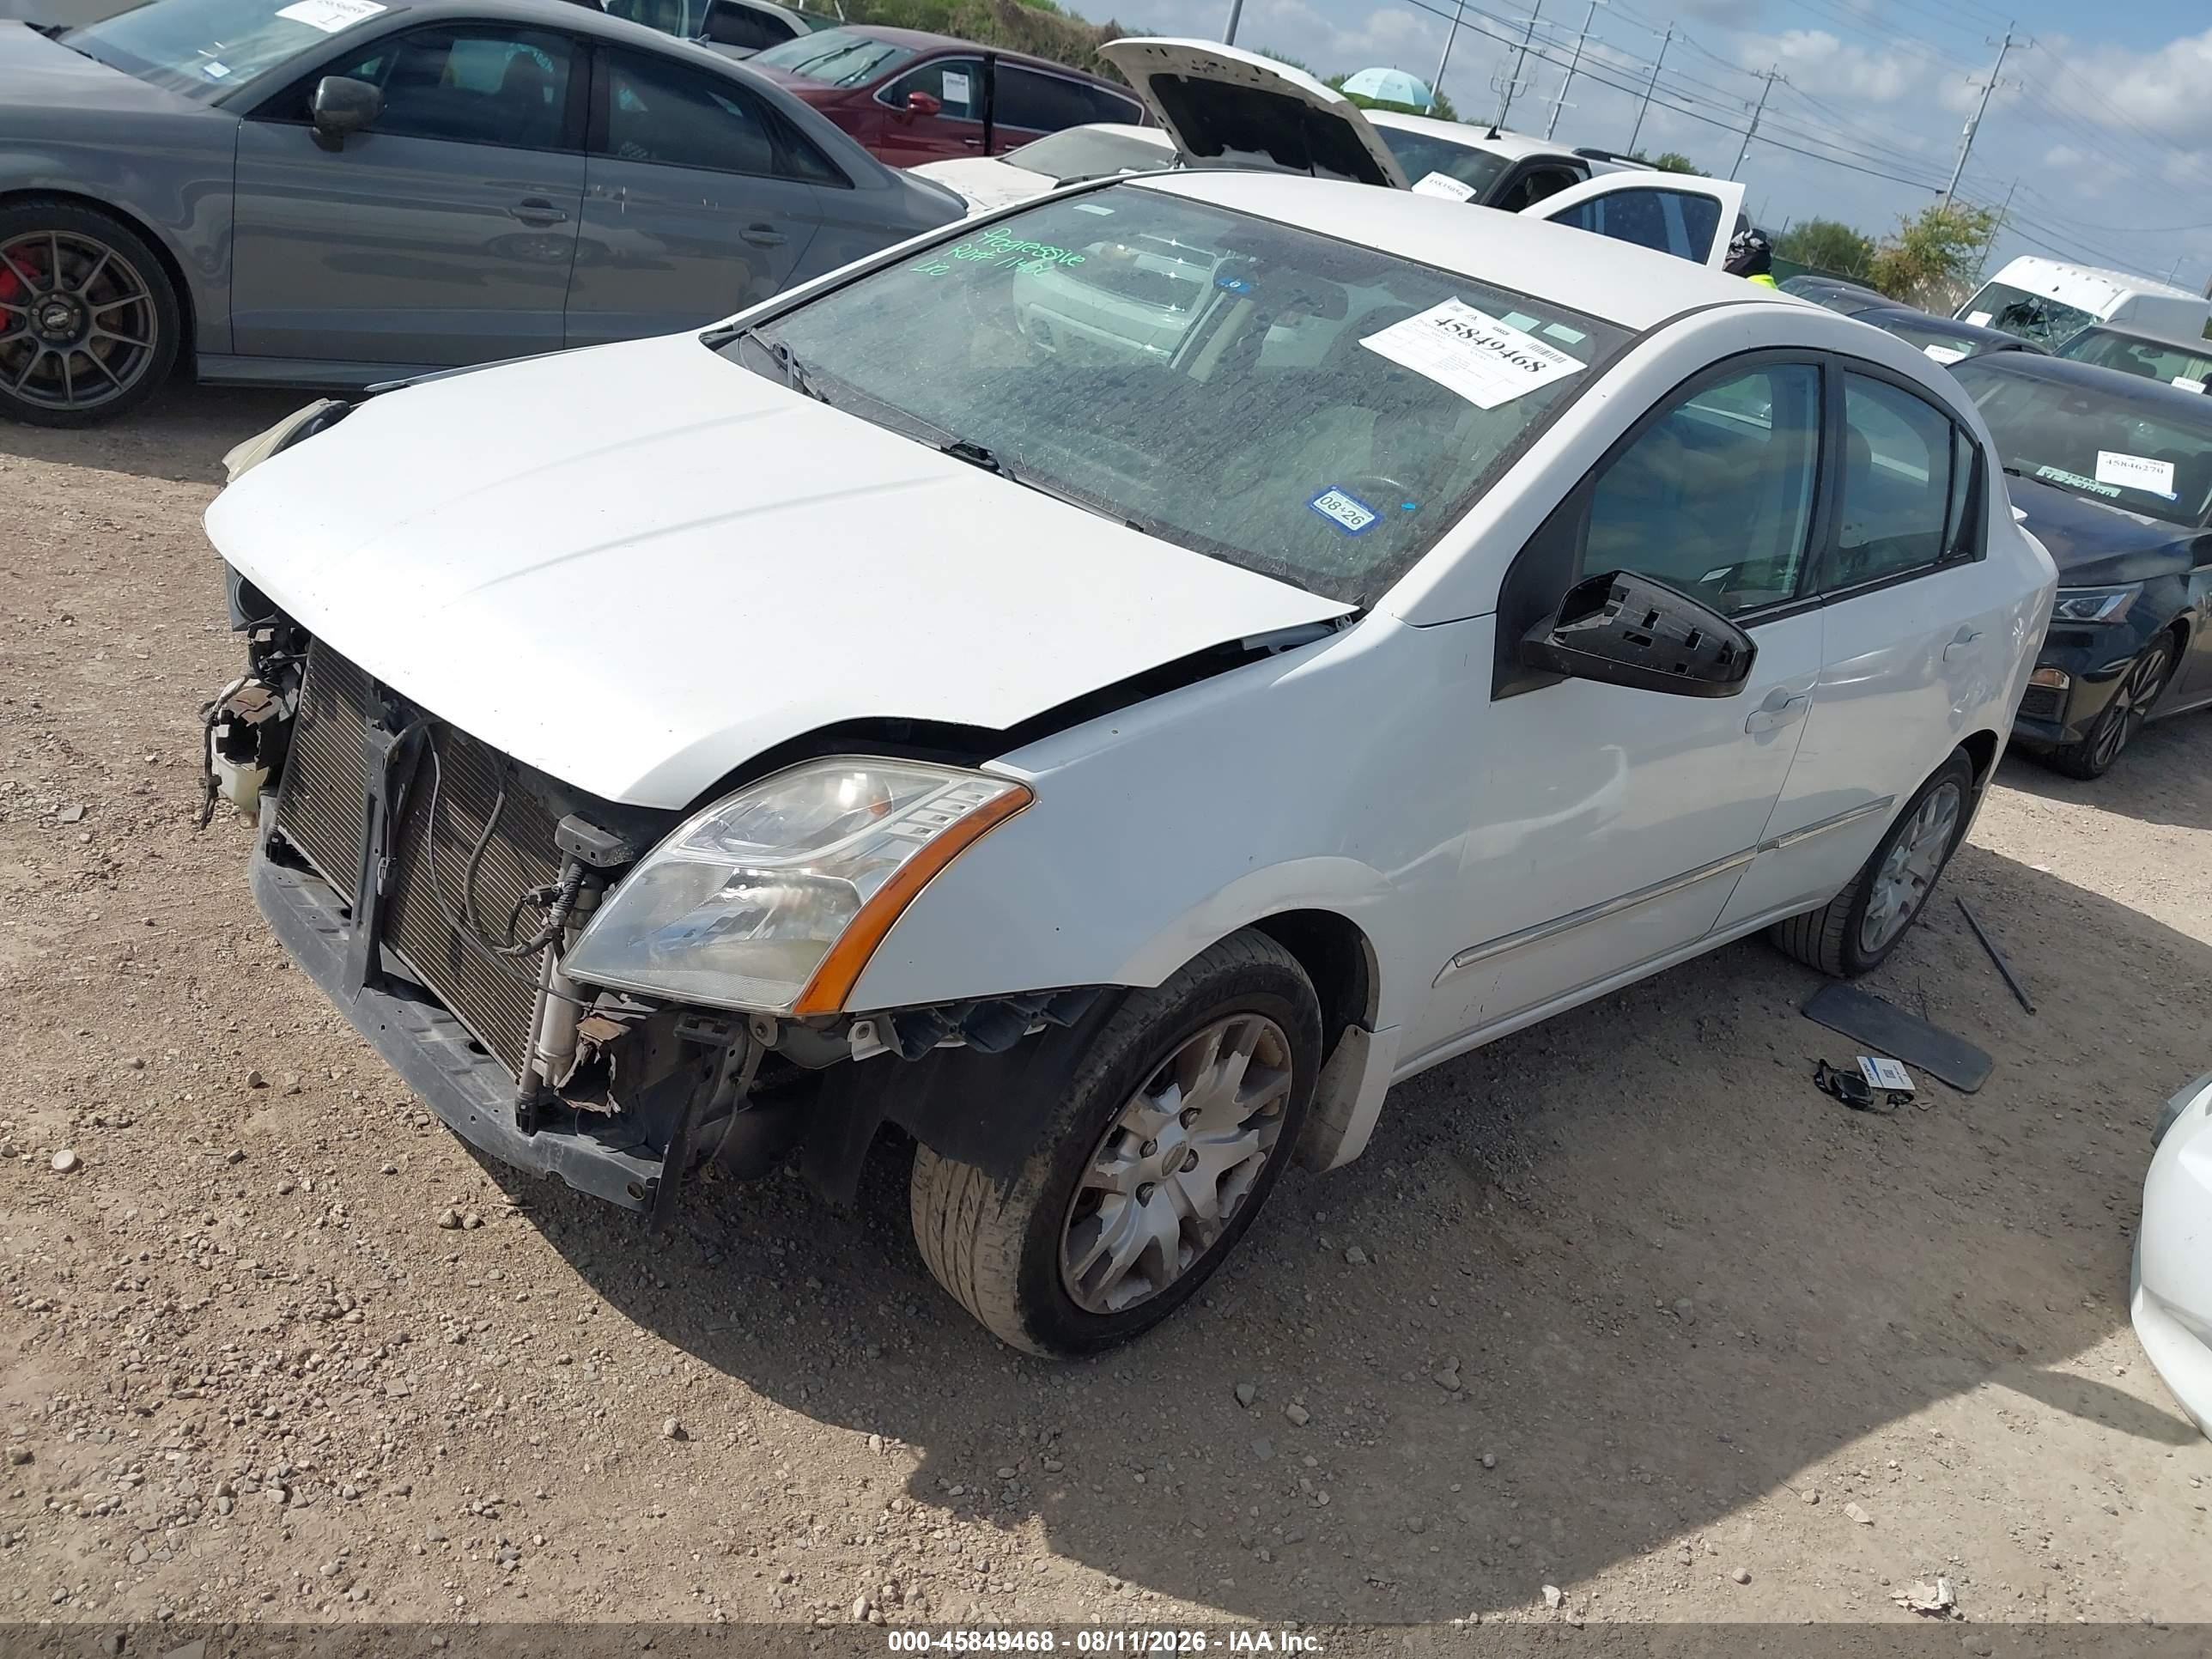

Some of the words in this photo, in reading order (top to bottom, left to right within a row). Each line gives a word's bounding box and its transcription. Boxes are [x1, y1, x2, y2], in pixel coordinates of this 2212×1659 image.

[1433, 317, 1547, 373] 45849468
[1319, 496, 1341, 511] 08
[1341, 510, 1365, 526] 26
